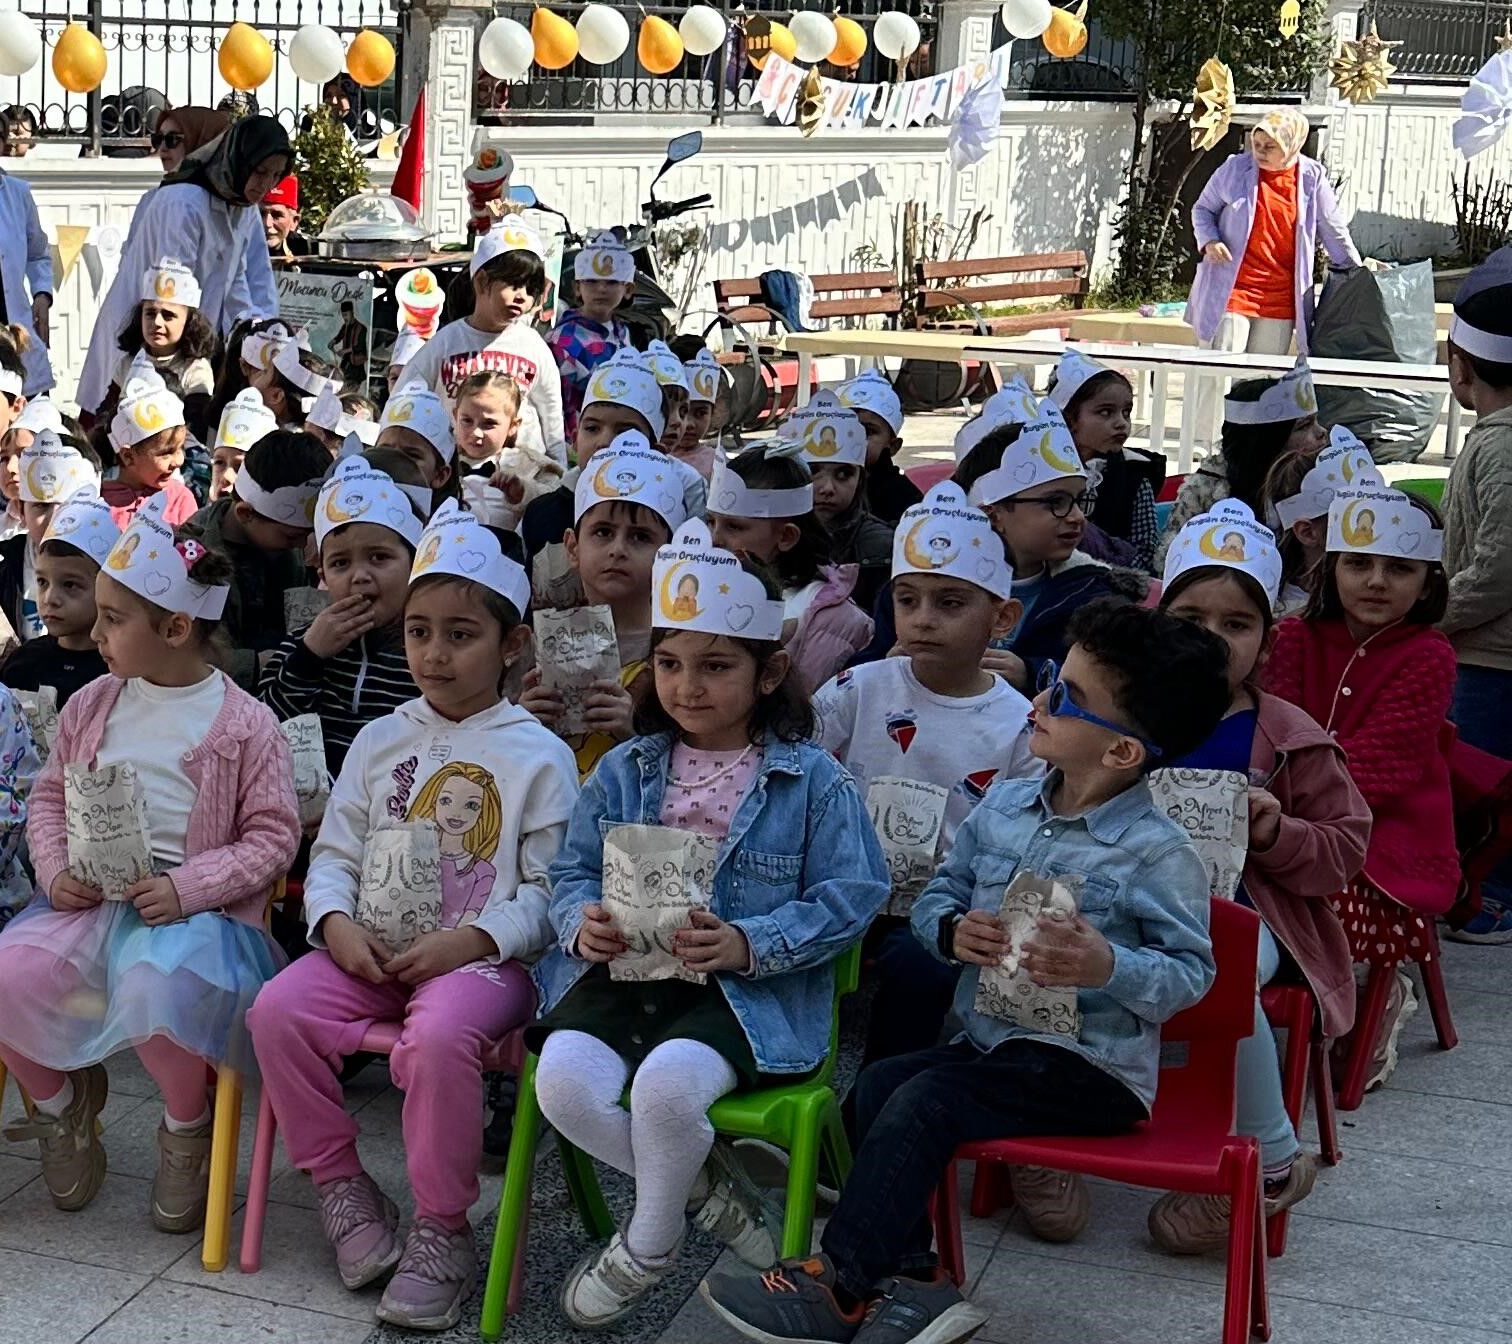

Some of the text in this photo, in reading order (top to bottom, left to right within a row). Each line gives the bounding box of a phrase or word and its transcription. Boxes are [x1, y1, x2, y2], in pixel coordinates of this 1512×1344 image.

[936, 494, 955, 503] Ben
[682, 535, 701, 546] Ben
[678, 550, 738, 568] Oruçluyum
[386, 756, 418, 821] Barbie
